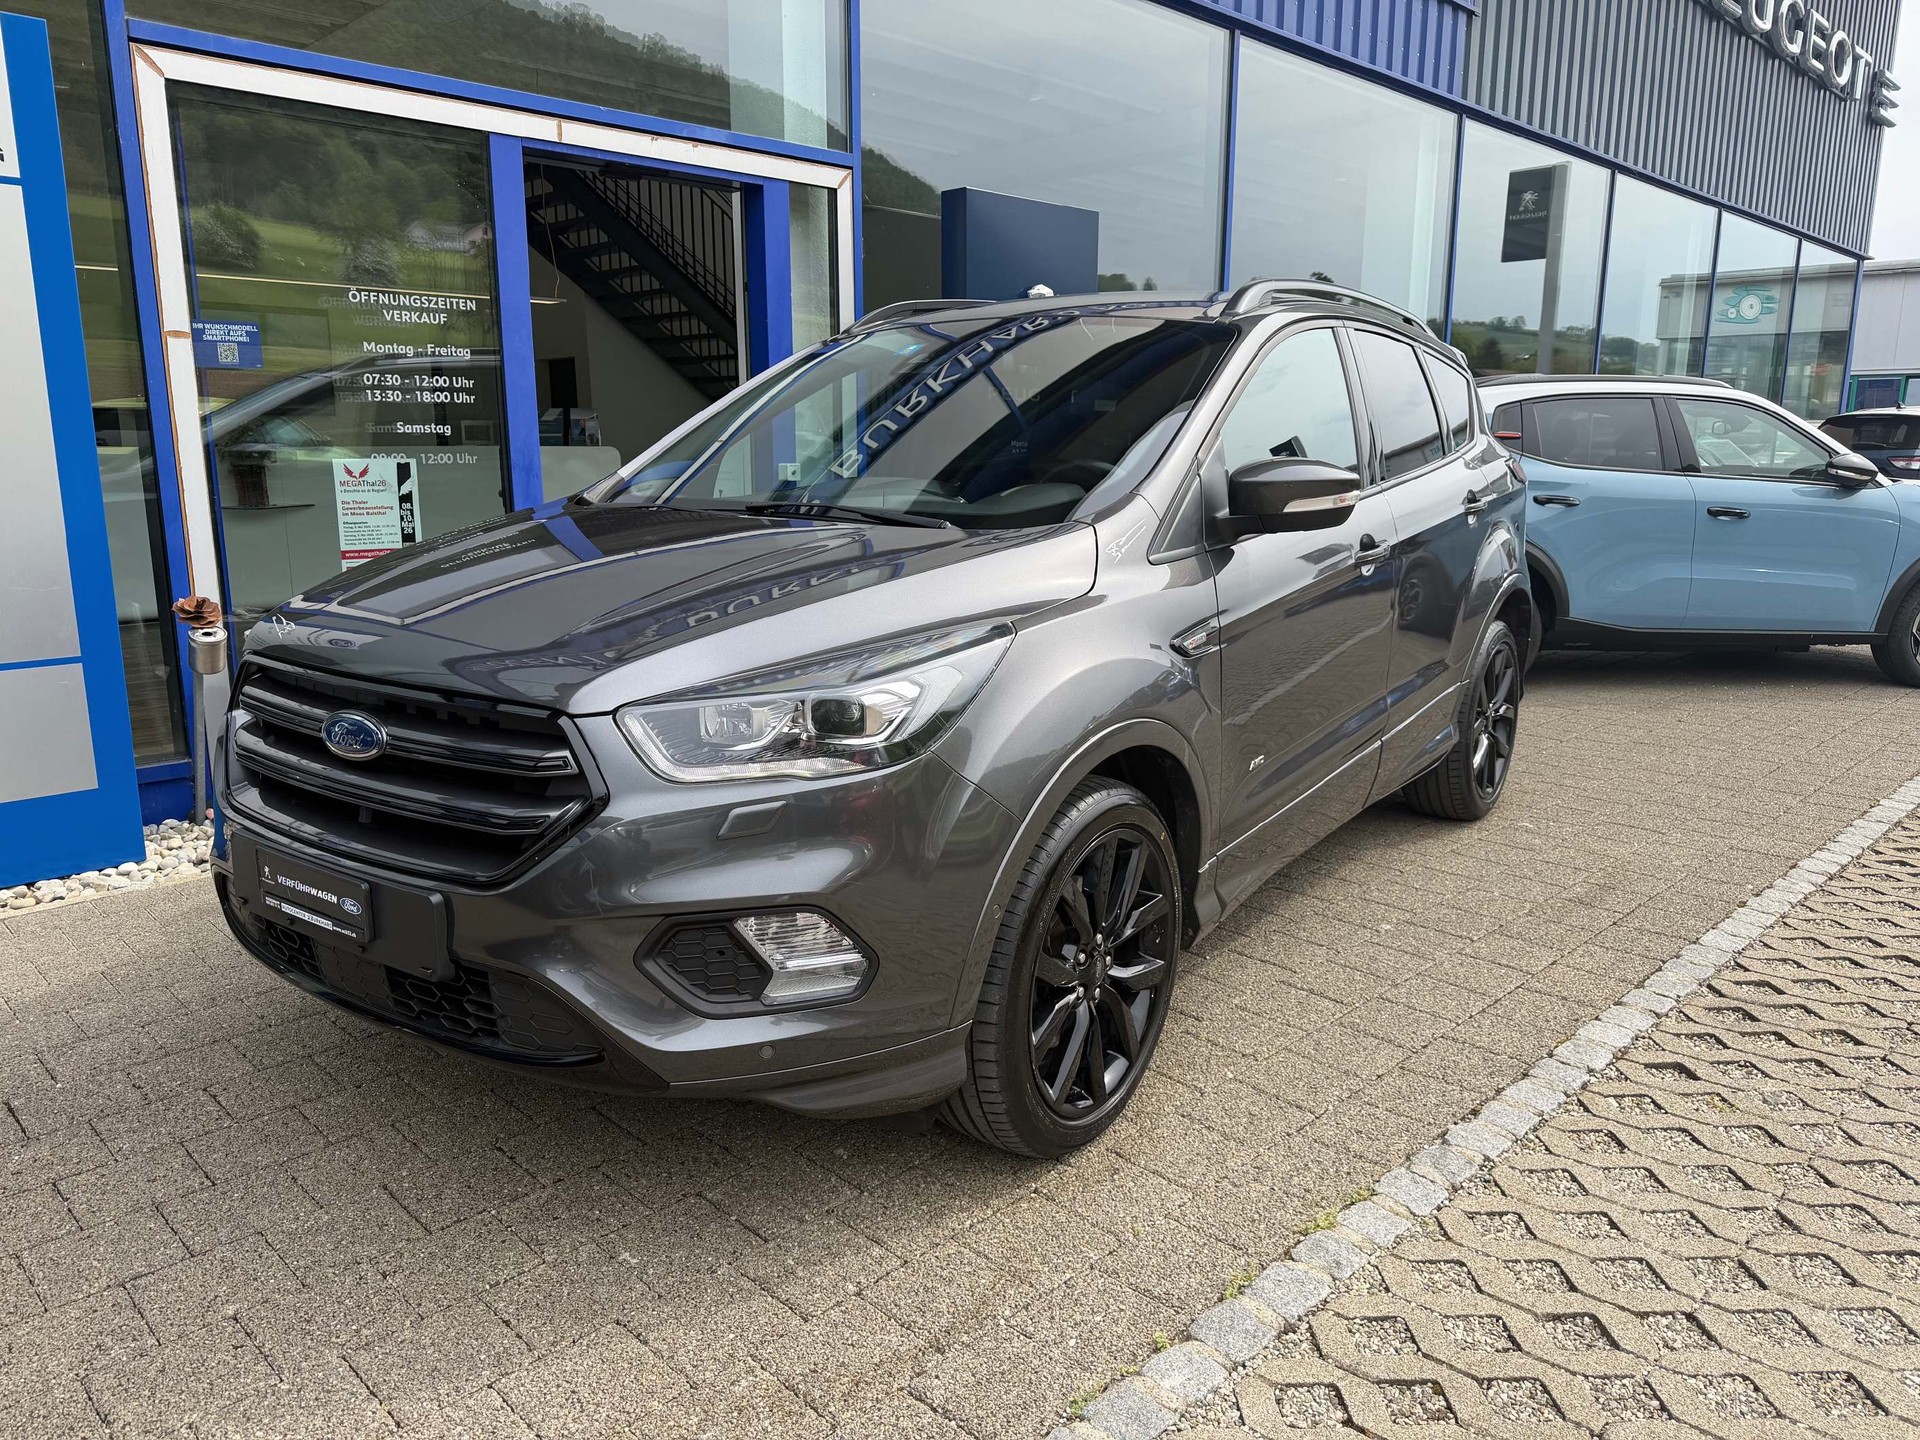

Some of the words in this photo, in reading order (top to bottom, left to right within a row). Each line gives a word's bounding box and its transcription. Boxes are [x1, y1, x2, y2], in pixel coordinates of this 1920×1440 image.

[1713, 0, 1872, 101] UGEOT
[348, 287, 476, 311] ÖFFNUNGSZEITEN
[383, 309, 448, 325] VERKAUF
[204, 323, 259, 332] WUNSCHMODELL
[202, 334, 250, 343] SMARTPHONE!
[363, 341, 414, 356] Montag
[427, 343, 471, 359] Freitag
[363, 373, 401, 386] 07:30
[414, 375, 450, 388] 12:00
[452, 376, 475, 388] Uhr
[366, 389, 402, 402] 13:30
[415, 391, 451, 404] 18:00
[453, 392, 476, 404] Uhr
[396, 421, 452, 436] Samstag
[420, 453, 454, 465] 12:00
[456, 452, 478, 464] Uhr
[339, 480, 387, 488] MEGAThal26
[341, 504, 394, 512] Gewerbeausstellung
[401, 502, 413, 510] 08.
[331, 721, 365, 749] Ford
[276, 874, 338, 904] VERFÜHRWAGEN
